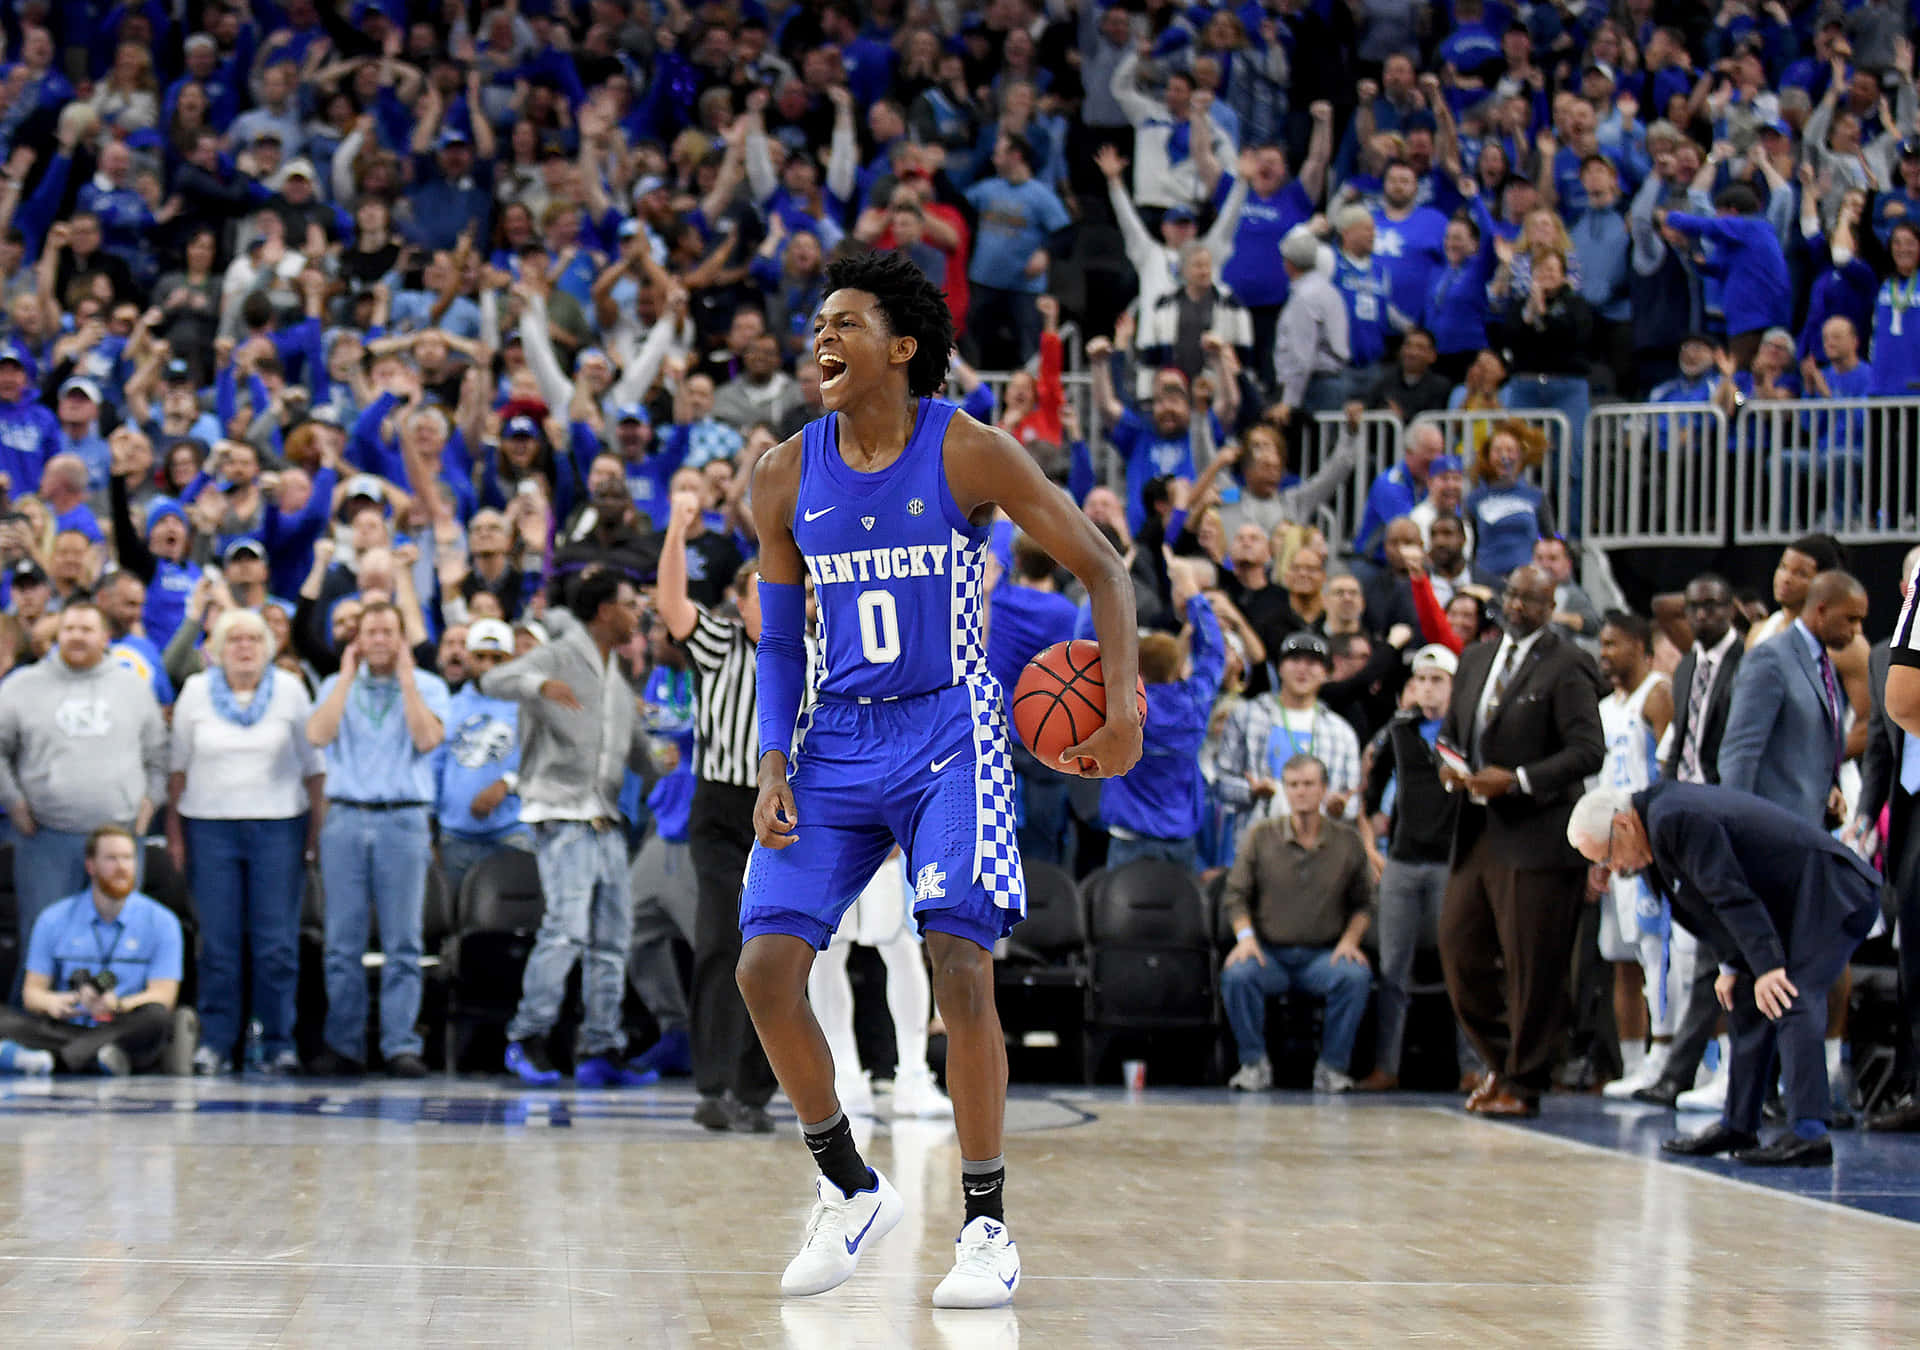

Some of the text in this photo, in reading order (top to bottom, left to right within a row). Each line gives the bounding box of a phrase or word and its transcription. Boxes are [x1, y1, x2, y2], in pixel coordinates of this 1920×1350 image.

[907, 499, 925, 516] SEC
[804, 545, 948, 586] KENTUCKY
[857, 590, 900, 664] 0
[915, 861, 946, 902] UK
